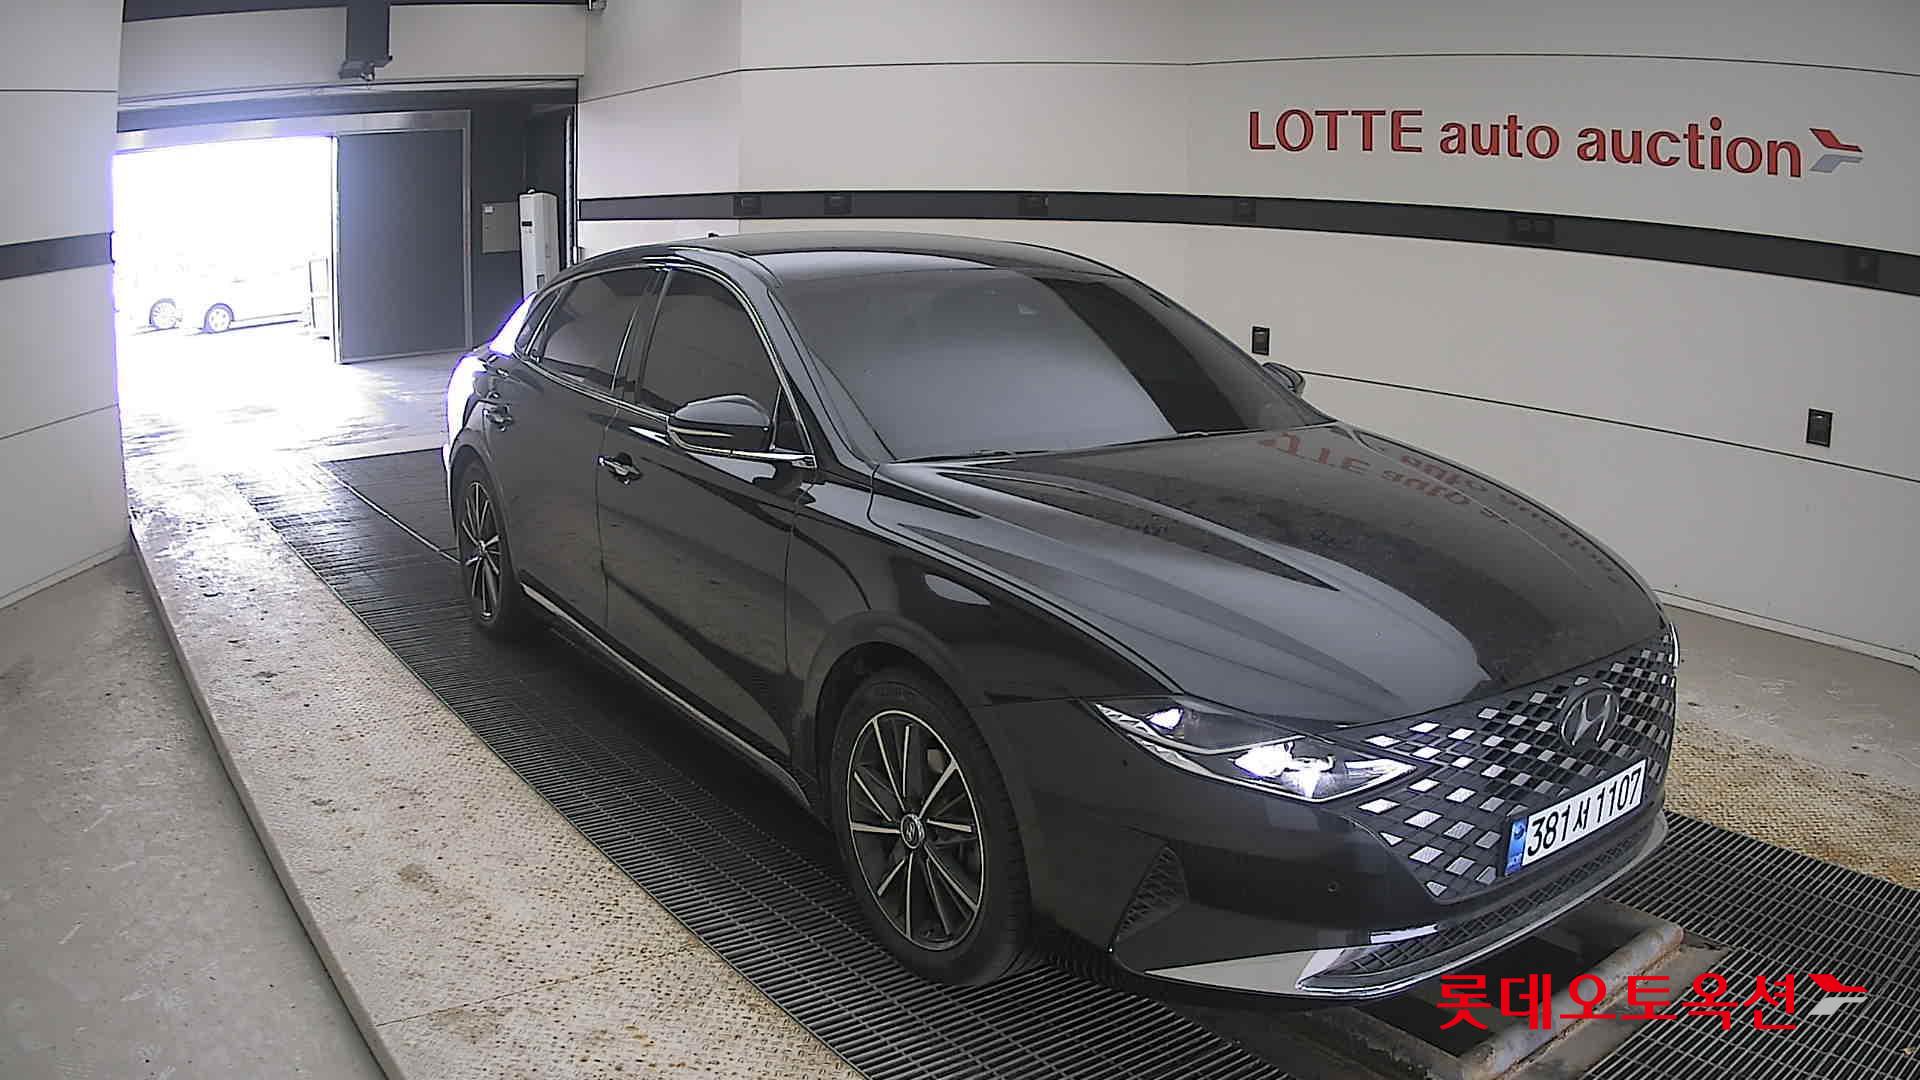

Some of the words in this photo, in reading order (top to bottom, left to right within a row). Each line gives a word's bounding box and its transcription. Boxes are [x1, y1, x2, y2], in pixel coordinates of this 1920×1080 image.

[1248, 110, 1424, 152] LOTTE
[1439, 114, 1560, 160] auto
[1577, 116, 1803, 177] auction
[1527, 797, 1591, 857] 381서
[1597, 767, 1641, 823] 1107
